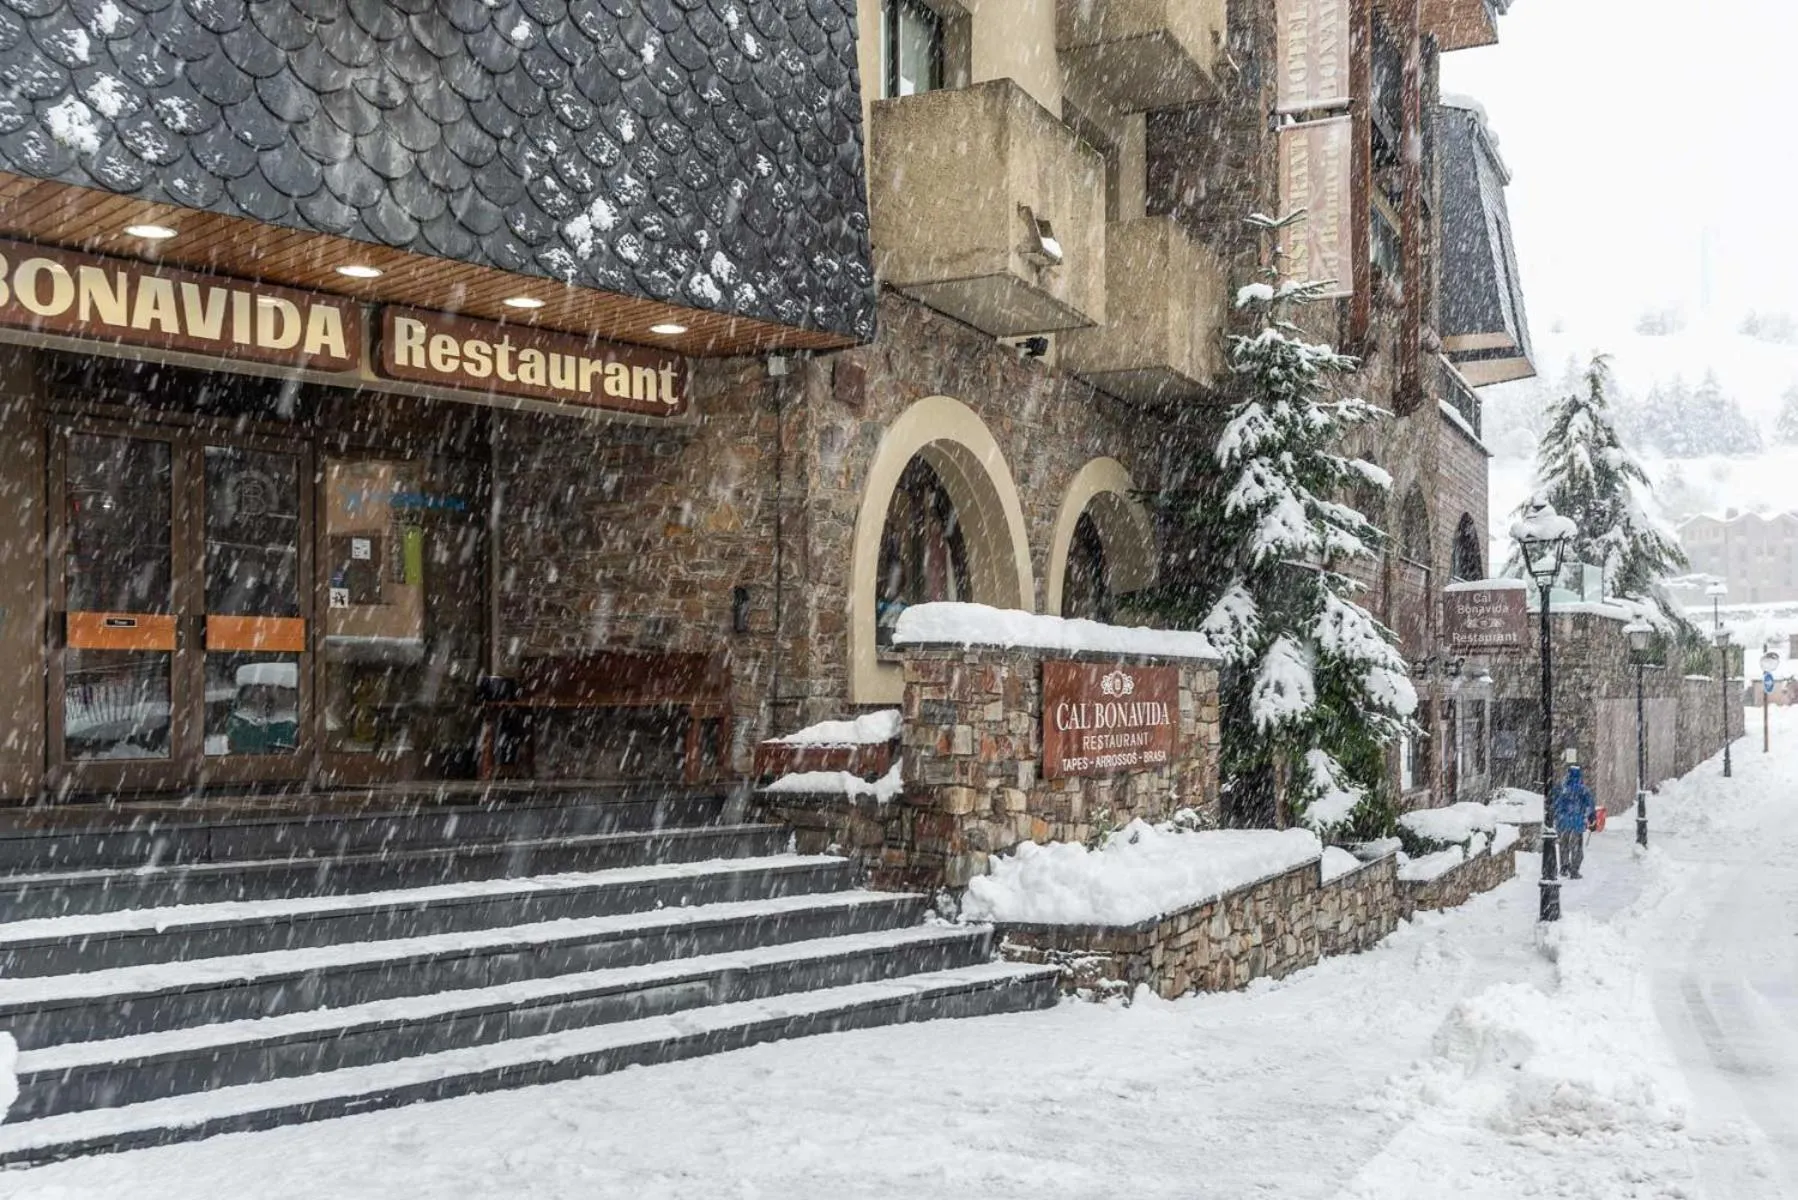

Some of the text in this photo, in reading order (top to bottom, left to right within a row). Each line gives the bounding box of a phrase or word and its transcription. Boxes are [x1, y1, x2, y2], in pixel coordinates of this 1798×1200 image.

[0, 252, 348, 359] ONAVIDA
[394, 315, 681, 405] Restaurant
[1472, 592, 1492, 604] Cal
[1456, 603, 1509, 616] Bonavida
[1452, 631, 1518, 643] Restaurant
[1056, 701, 1171, 731] CAL BONAVIDA
[1083, 732, 1150, 751] RESTAURANT
[1062, 757, 1088, 772] TAPES
[1095, 751, 1137, 769] ARROSSOS
[1143, 750, 1167, 763] BRASA
